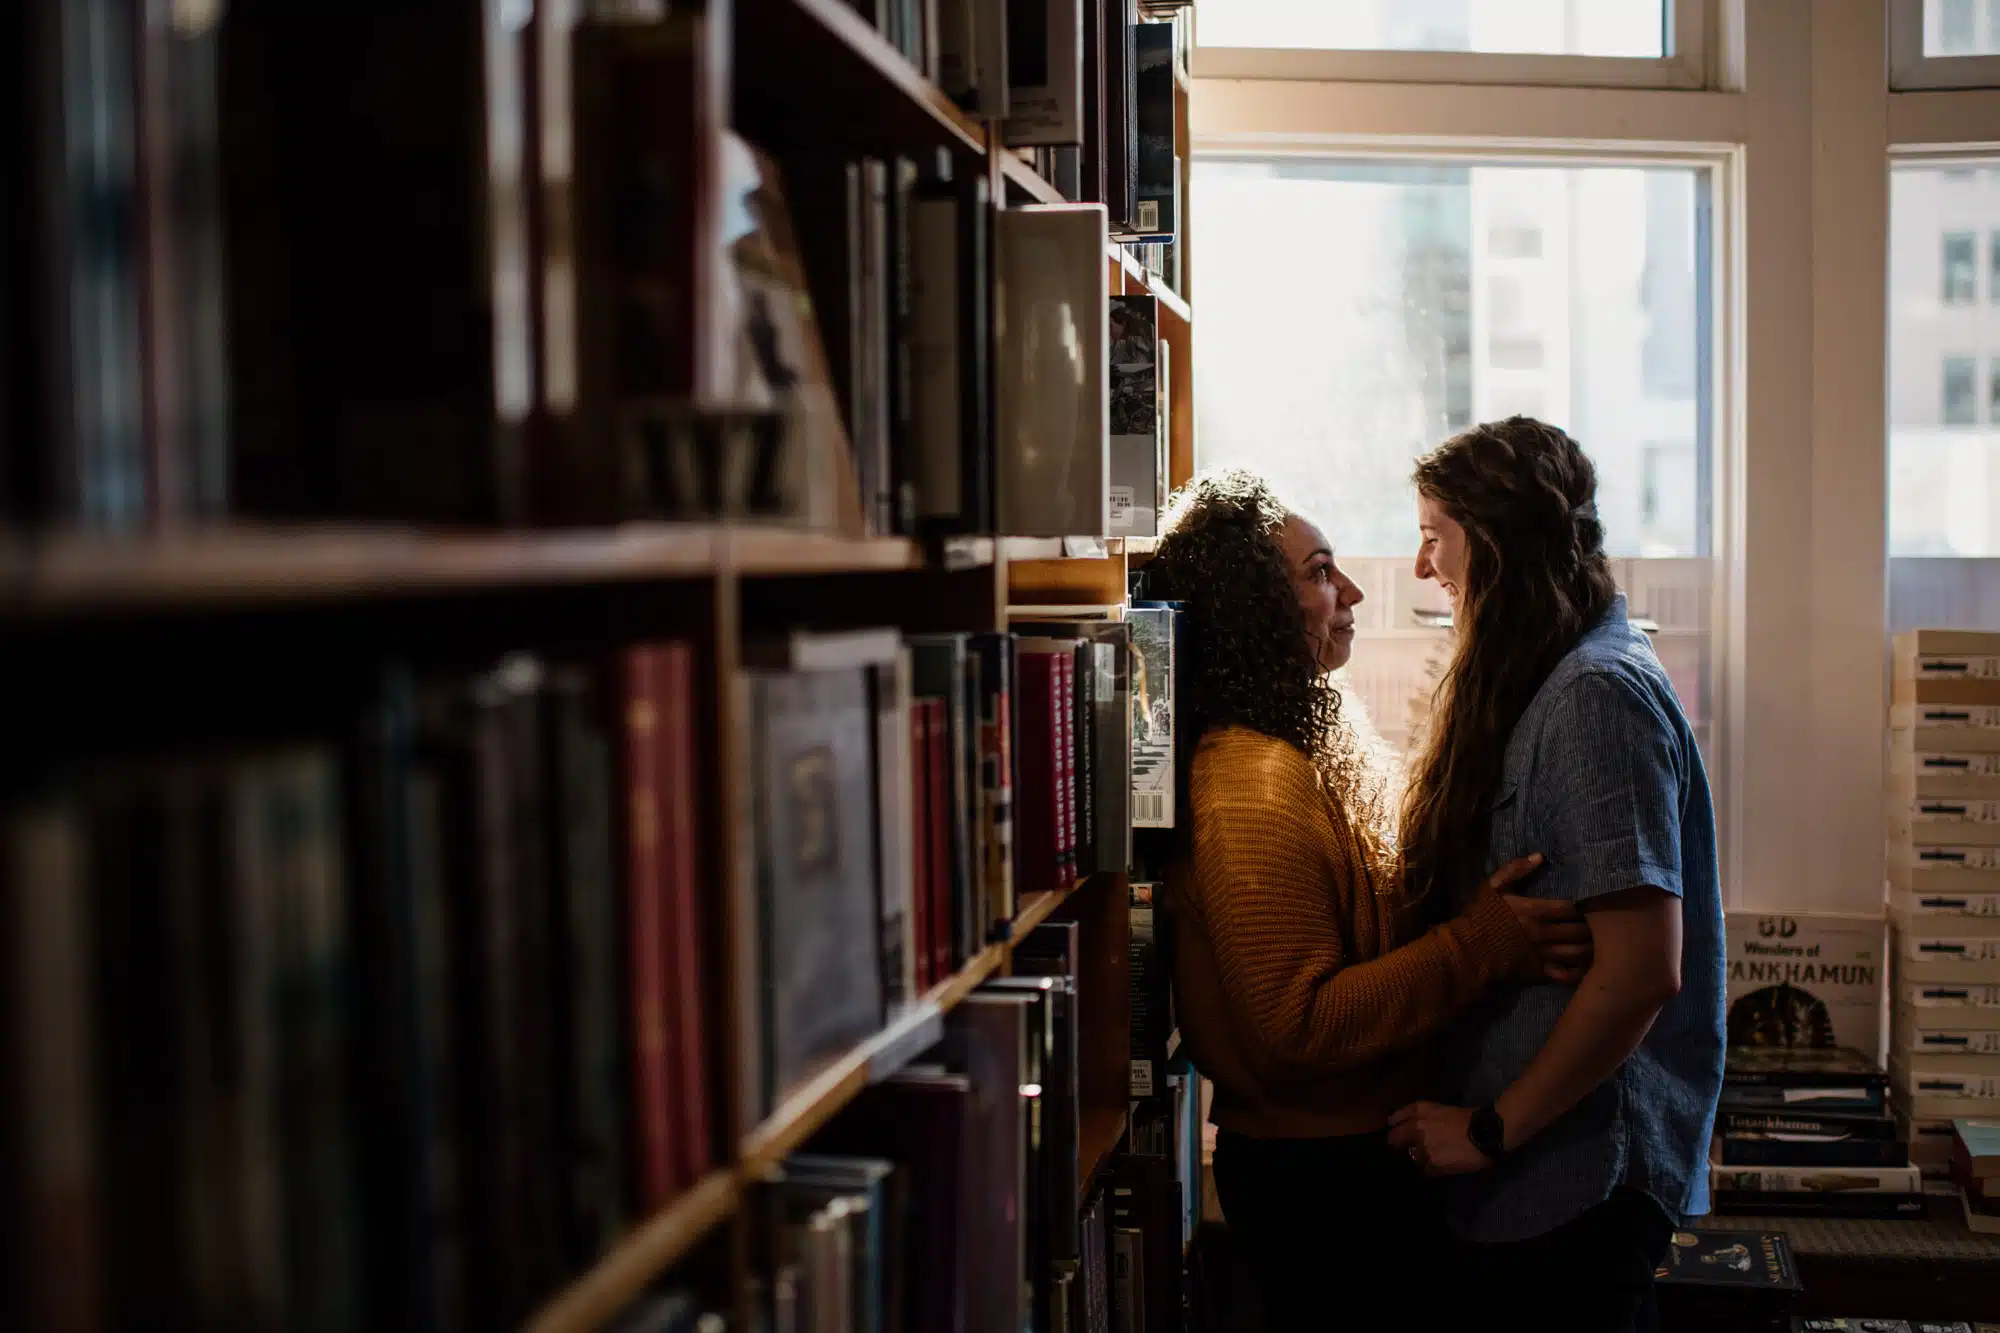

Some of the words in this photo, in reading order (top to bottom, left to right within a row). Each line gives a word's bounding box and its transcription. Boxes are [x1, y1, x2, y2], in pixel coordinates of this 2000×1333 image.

[1744, 940, 1803, 957] Wonders
[1806, 943, 1820, 957] of
[1727, 960, 1876, 985] ANKHAMUN
